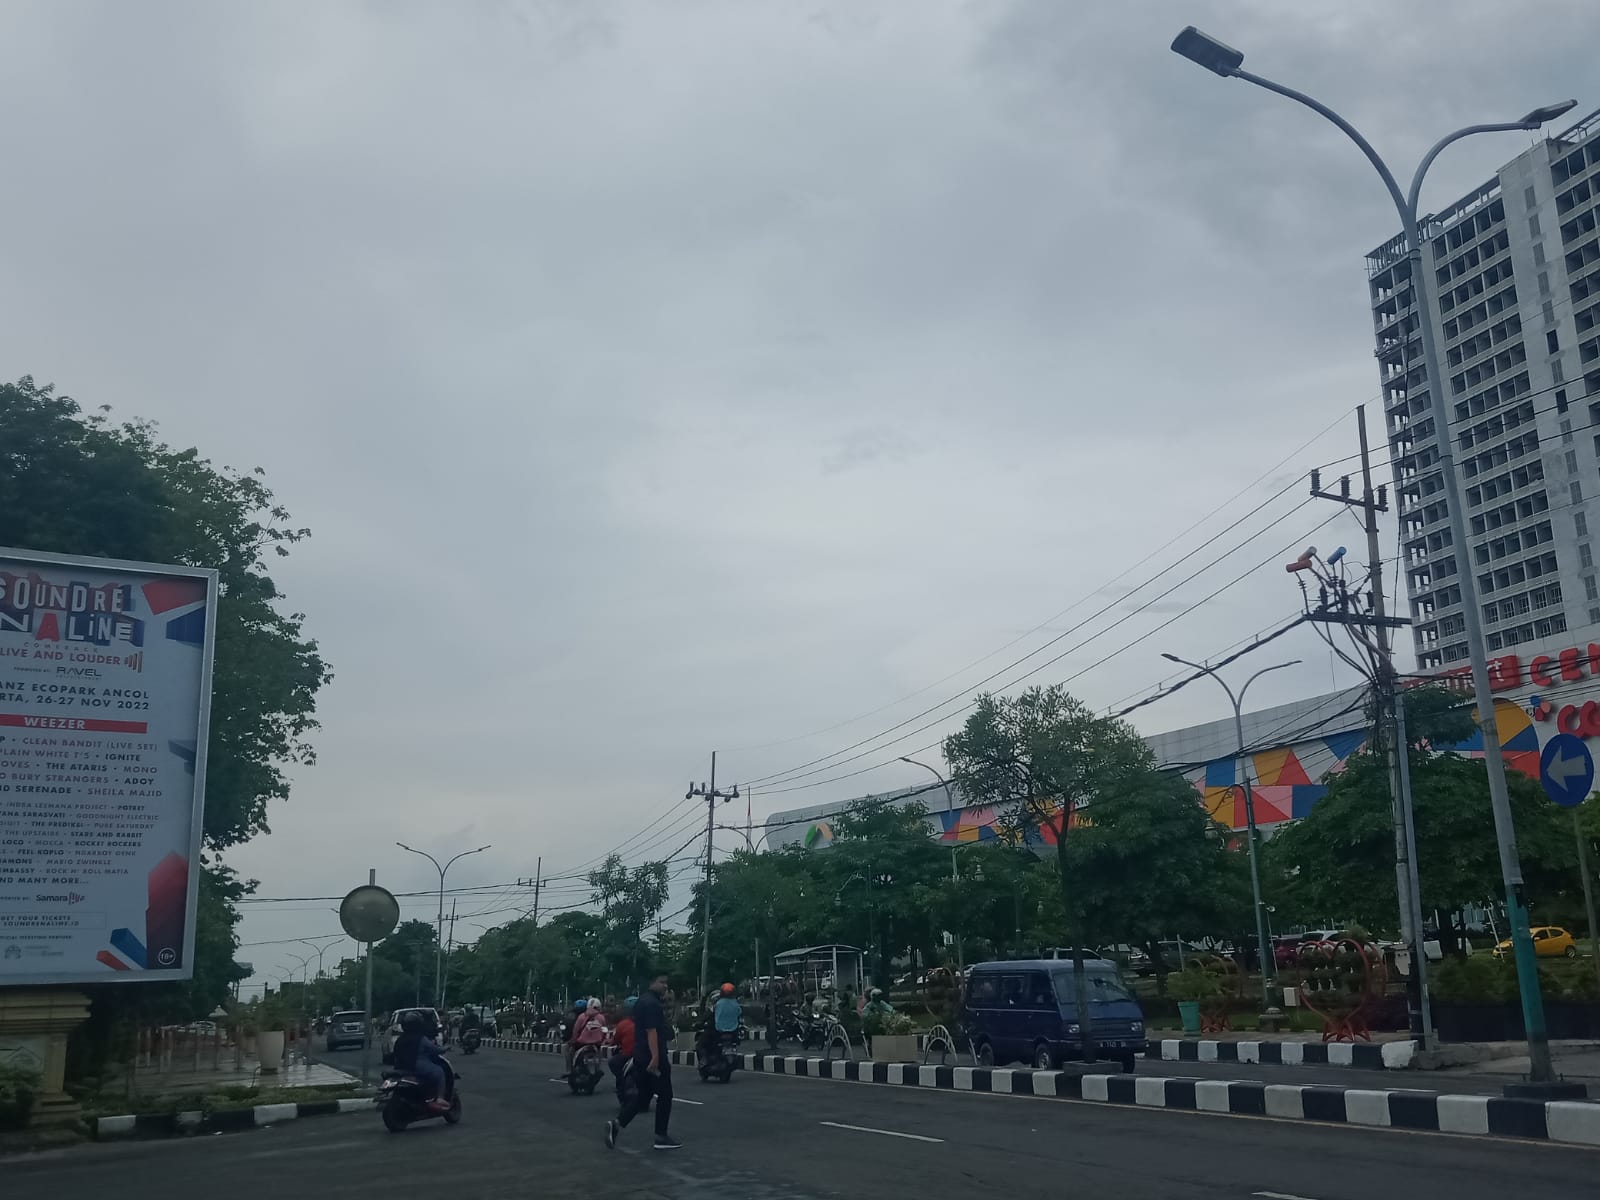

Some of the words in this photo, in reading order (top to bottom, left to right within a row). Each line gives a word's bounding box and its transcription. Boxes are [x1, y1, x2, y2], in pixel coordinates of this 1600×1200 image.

[0, 647, 28, 658] LIVE
[33, 650, 64, 660] AND
[70, 653, 120, 665] LOUDER
[0, 680, 24, 691] NZ
[32, 683, 96, 696] ECOPARK
[102, 688, 149, 700] ANCOL
[36, 695, 74, 706] 26-27
[80, 698, 111, 708] NOV
[117, 700, 149, 710] 2022
[24, 717, 86, 729] WEEZER
[22, 737, 57, 746] CLEAN
[62, 739, 102, 748] BANDIT
[106, 741, 132, 750] (LIVE
[35, 750, 70, 758] WHITE
[105, 754, 140, 762] IGNITE
[1, 760, 30, 768] OVES
[46, 762, 64, 770] THE
[70, 764, 108, 772] ATARIS
[12, 773, 40, 781] BURY
[46, 774, 109, 784] STRANGERS
[16, 786, 72, 794] SERENADE
[88, 788, 124, 796] SHEILA
